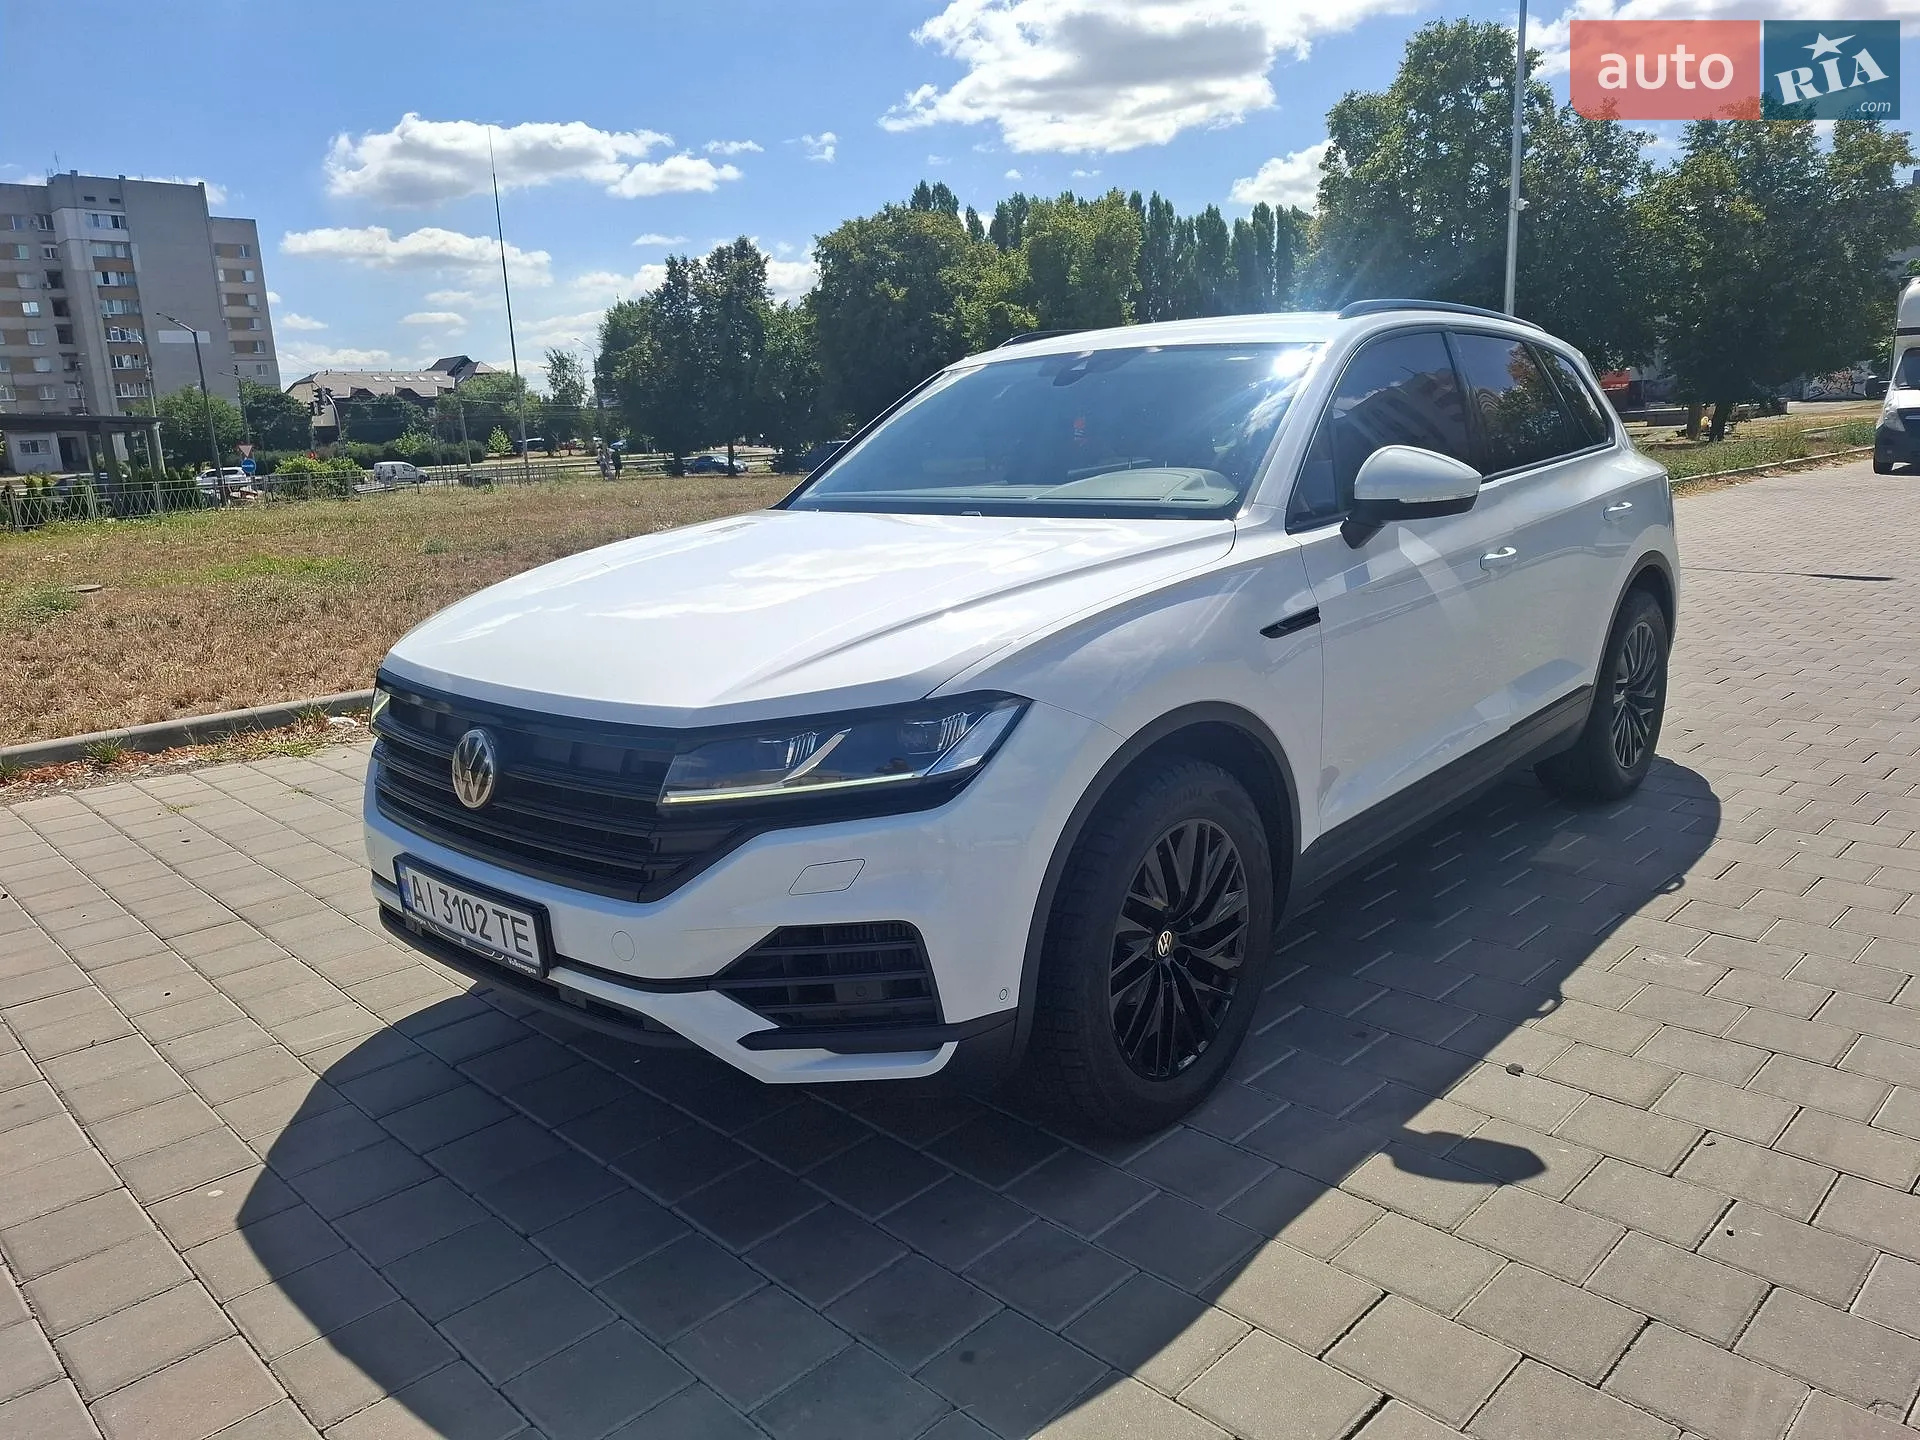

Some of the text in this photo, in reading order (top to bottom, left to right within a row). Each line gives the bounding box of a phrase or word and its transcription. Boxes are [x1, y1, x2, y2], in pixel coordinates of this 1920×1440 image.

[412, 875, 533, 958] AI 3102 TE
